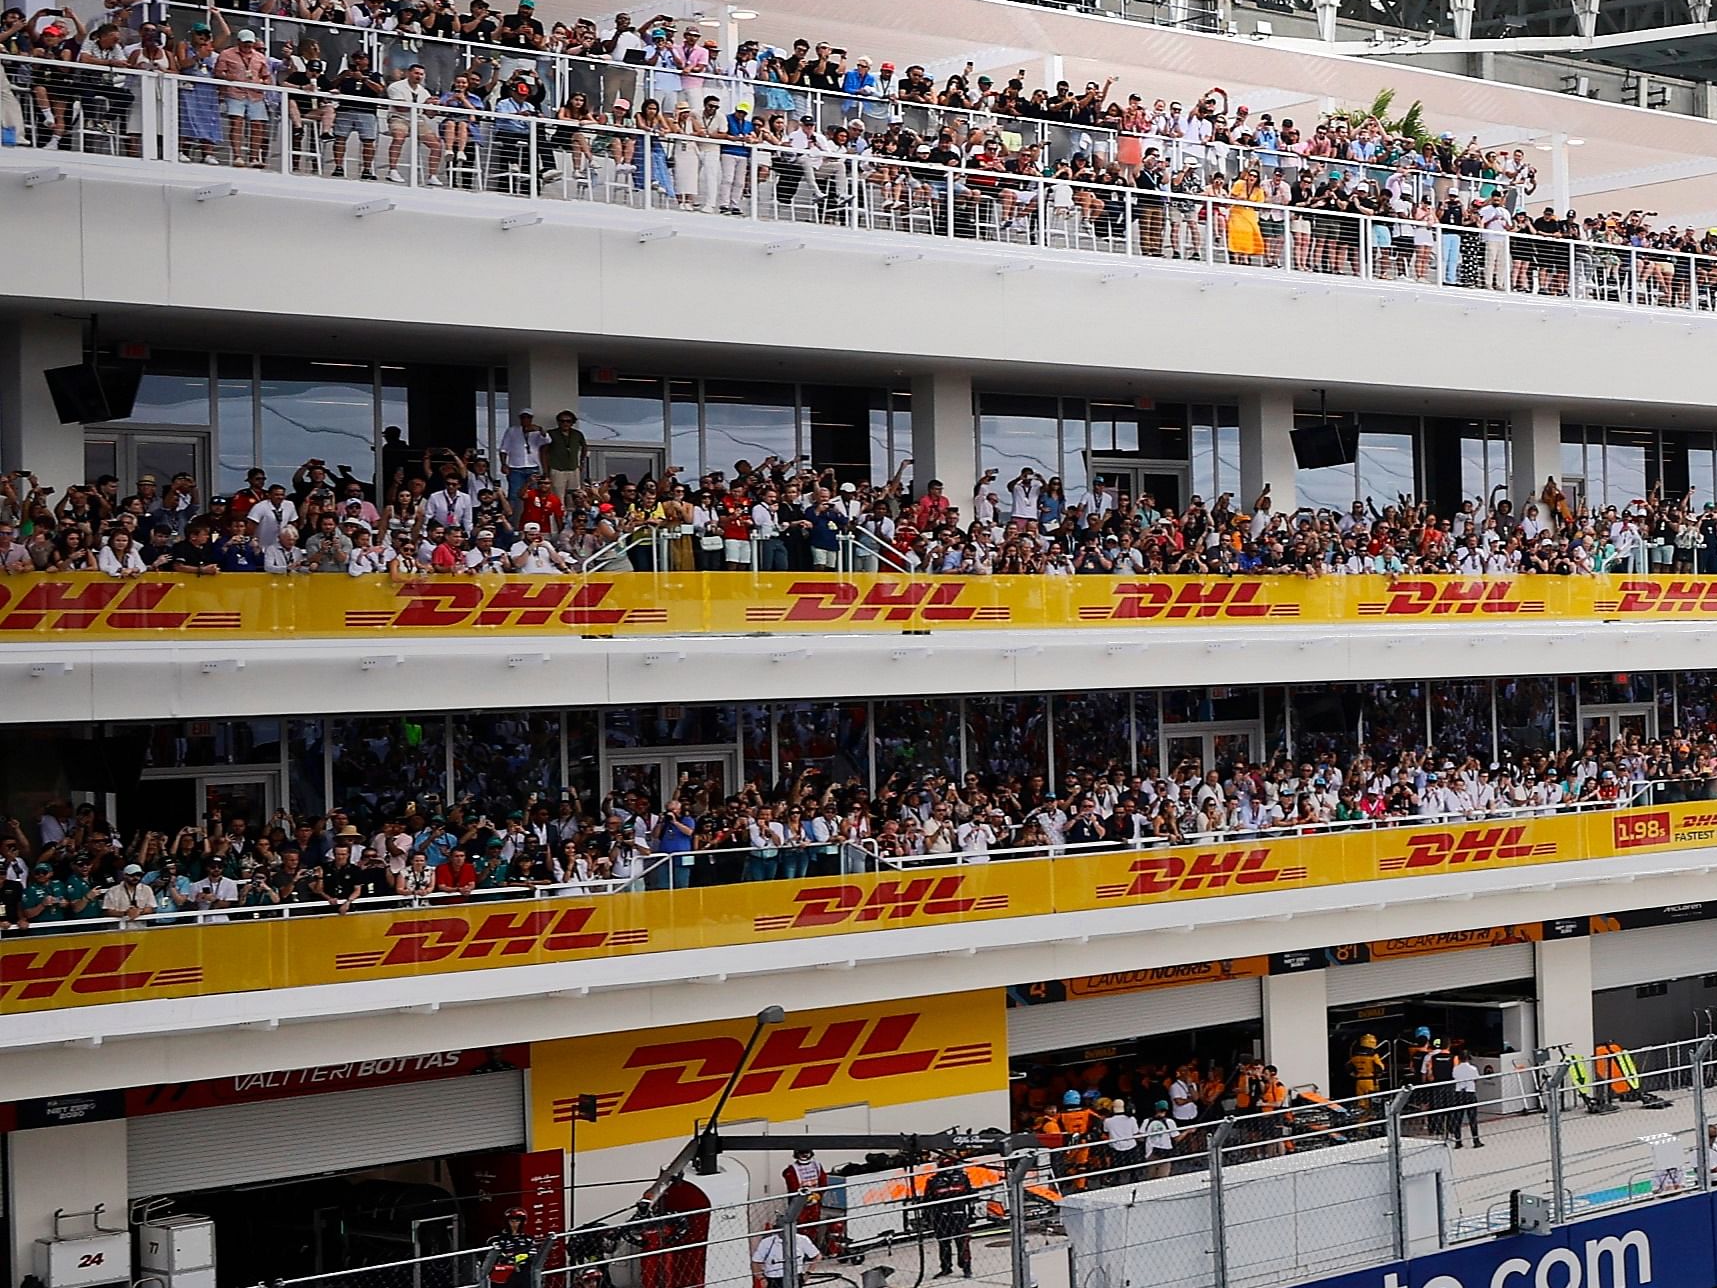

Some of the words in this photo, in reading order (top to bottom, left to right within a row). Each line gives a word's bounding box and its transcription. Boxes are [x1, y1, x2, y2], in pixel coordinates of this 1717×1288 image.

[0, 583, 190, 629] HL
[391, 582, 631, 627] DHL
[784, 582, 981, 621] DHL
[1109, 583, 1275, 618] DHL
[1384, 581, 1528, 614] DHL
[1405, 826, 1534, 869] DHL
[1617, 820, 1665, 841] 1.98s
[1674, 830, 1714, 842] FASTEST
[1126, 848, 1280, 896] DHL
[791, 876, 975, 927] DHL
[381, 908, 608, 965] DHL
[356, 1050, 462, 1077] BOTTAS
[618, 1013, 939, 1113] DHL
[77, 1251, 105, 1269] 24
